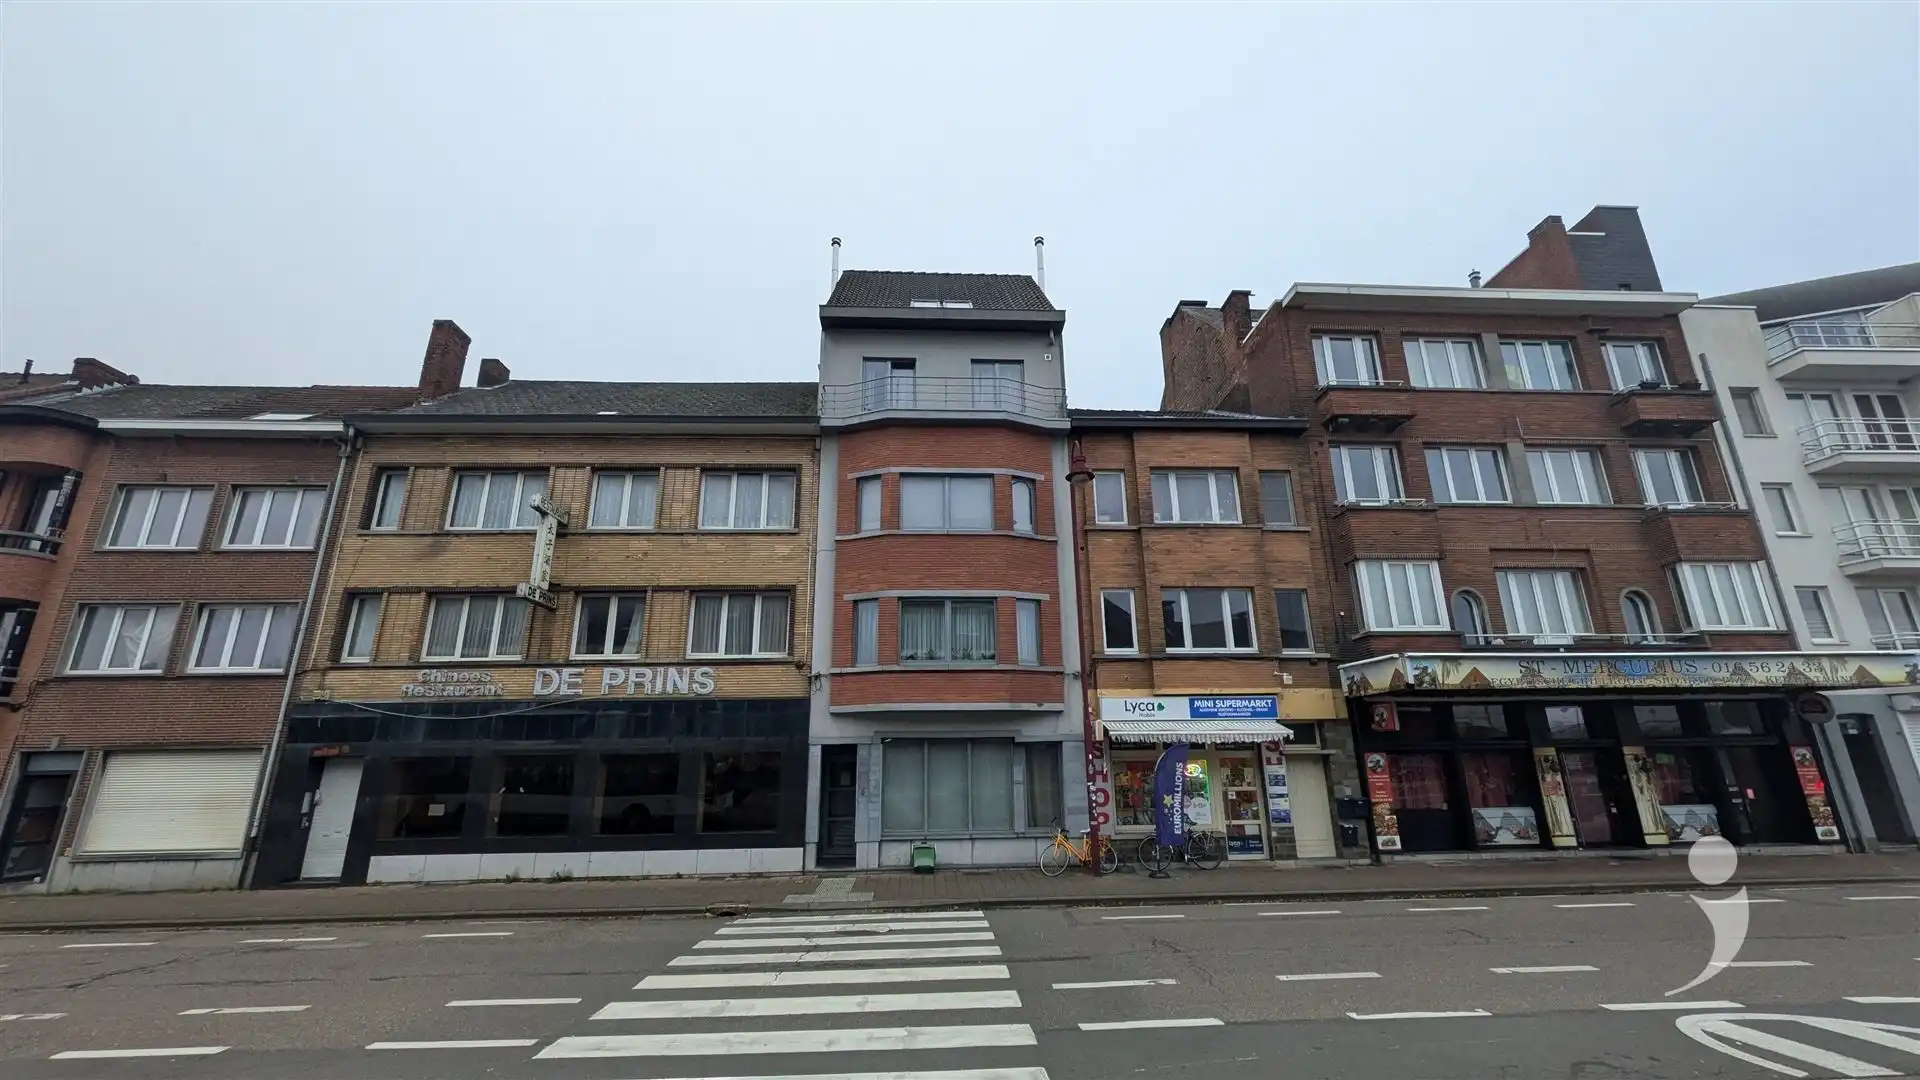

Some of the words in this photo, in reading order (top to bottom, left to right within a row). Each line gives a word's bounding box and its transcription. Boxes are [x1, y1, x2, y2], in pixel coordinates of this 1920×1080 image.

[527, 586, 537, 599] DE
[538, 590, 556, 607] PRINS
[1519, 659, 1545, 675] ST
[1562, 659, 1699, 675] MERCURIUS
[1711, 660, 1744, 674] 016
[1748, 660, 1771, 674] 56
[1775, 660, 1797, 674] 24
[417, 669, 493, 683] Chinees
[533, 667, 586, 696] DE
[600, 667, 716, 696] PRINS
[400, 683, 504, 697] Restaurant
[1124, 700, 1155, 714] Lyca
[1194, 700, 1214, 708] MINI
[1215, 699, 1273, 708] SUPERMARKT
[1173, 761, 1184, 835] EUROMILLIONS
